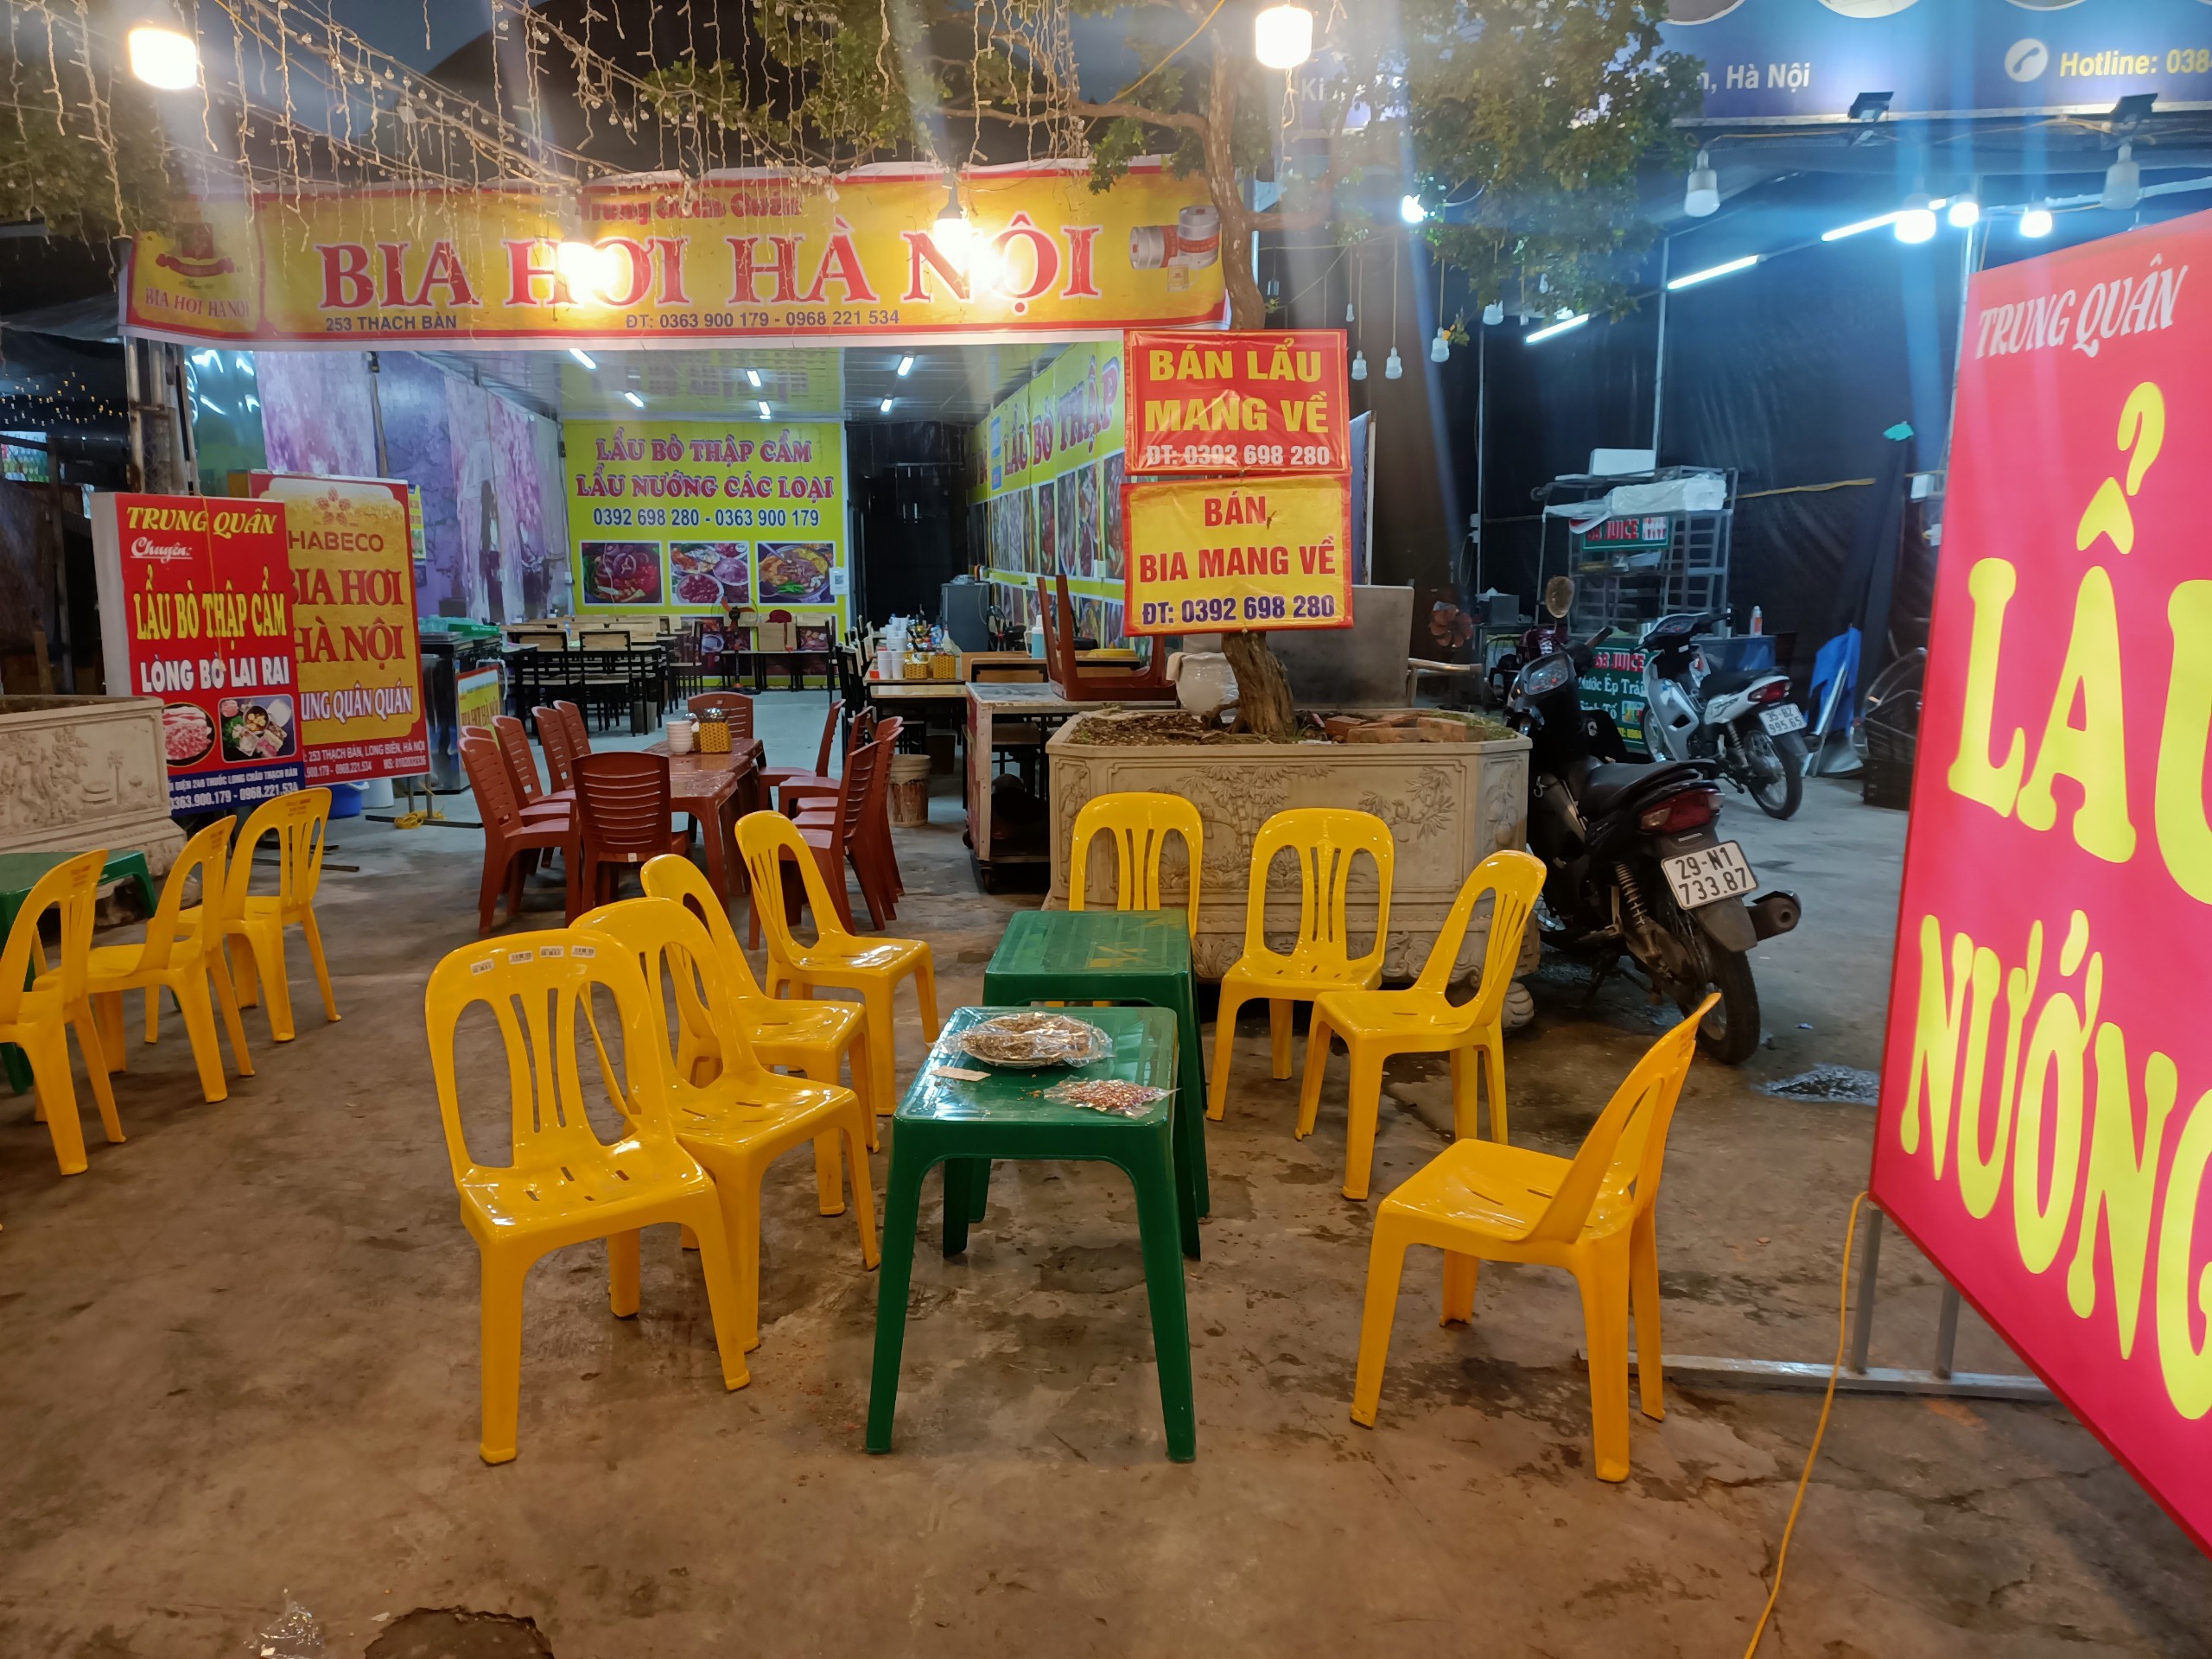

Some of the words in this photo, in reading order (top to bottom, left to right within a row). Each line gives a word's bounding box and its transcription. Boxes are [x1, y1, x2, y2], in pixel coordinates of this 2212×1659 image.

[1726, 63, 1759, 89] Hà
[1768, 62, 1810, 93] Nội
[2060, 49, 2158, 77] Hotline:
[2167, 49, 2212, 73] 038
[317, 241, 480, 308] BIA
[504, 238, 690, 306] HƠI
[727, 216, 876, 305] HÀ
[903, 213, 1100, 313] NỘI
[326, 316, 352, 331] 253
[422, 311, 457, 329] BÀN
[626, 314, 653, 327] ĐT:
[660, 313, 698, 327] 0363
[704, 312, 734, 327] 900
[740, 312, 768, 327] 179
[786, 311, 826, 326] 0968
[833, 310, 861, 325] 221
[868, 309, 899, 324] 534
[1975, 289, 2076, 359] TRUNG
[2072, 252, 2189, 358] QUÂN
[1149, 344, 1233, 381] BÁN
[1247, 337, 1322, 383] LẨU
[1033, 397, 1054, 466] BÒ
[1058, 354, 1120, 454] THẬP
[1145, 397, 1268, 432] MANG
[1281, 391, 1329, 433] VỀ
[596, 426, 645, 461] LẨU
[652, 433, 684, 461] BÒ
[690, 434, 754, 467] THẬP
[760, 429, 812, 462] CẨM
[1146, 445, 1178, 465] ĐT:
[1185, 444, 1237, 466] 0392
[1244, 444, 1283, 465] 698
[1290, 445, 1330, 466] 280
[575, 462, 626, 497] LẨU
[632, 469, 719, 498] NƯỚNG
[723, 470, 772, 499] CÁC
[778, 476, 835, 504] LOẠI
[127, 506, 209, 532] TRUNG
[213, 508, 277, 539] QUÂN
[594, 508, 632, 525] 0392
[638, 508, 666, 526] 698
[671, 508, 699, 526] 280
[715, 509, 753, 526] 0363
[758, 509, 786, 526] 900
[791, 509, 819, 526] 179
[1204, 490, 1266, 527] BÁN
[288, 530, 384, 552] HABECO
[1604, 518, 1639, 540] JUICE
[1140, 551, 1188, 583] BIA
[1198, 545, 1288, 579] MANG
[1299, 535, 1336, 575] VỀ
[338, 568, 404, 606] HƠI
[133, 563, 171, 639] LẨU
[175, 579, 200, 639] BÒ
[202, 578, 247, 650] THẬP
[251, 565, 287, 637] CẨM
[1142, 601, 1173, 625] ĐT:
[1181, 597, 1236, 622] 0392
[1244, 595, 1285, 620] 698
[1293, 594, 1334, 618] 280
[294, 616, 340, 664] HÀ
[340, 616, 406, 670] NỘI
[140, 653, 194, 692] LÒNG
[199, 652, 225, 690] BÒ
[229, 657, 257, 687] LAI
[261, 656, 290, 685] RAI
[1611, 652, 1645, 673] JUICE
[300, 690, 330, 721] UNG
[333, 680, 373, 725] QUÂN
[374, 677, 413, 721] QUÁN
[1605, 673, 1618, 695] Ép
[1769, 716, 1803, 734] 995.65
[321, 749, 346, 762] THẠCH
[1675, 847, 1733, 880] 29-N1
[1678, 867, 1747, 905] 733.87
